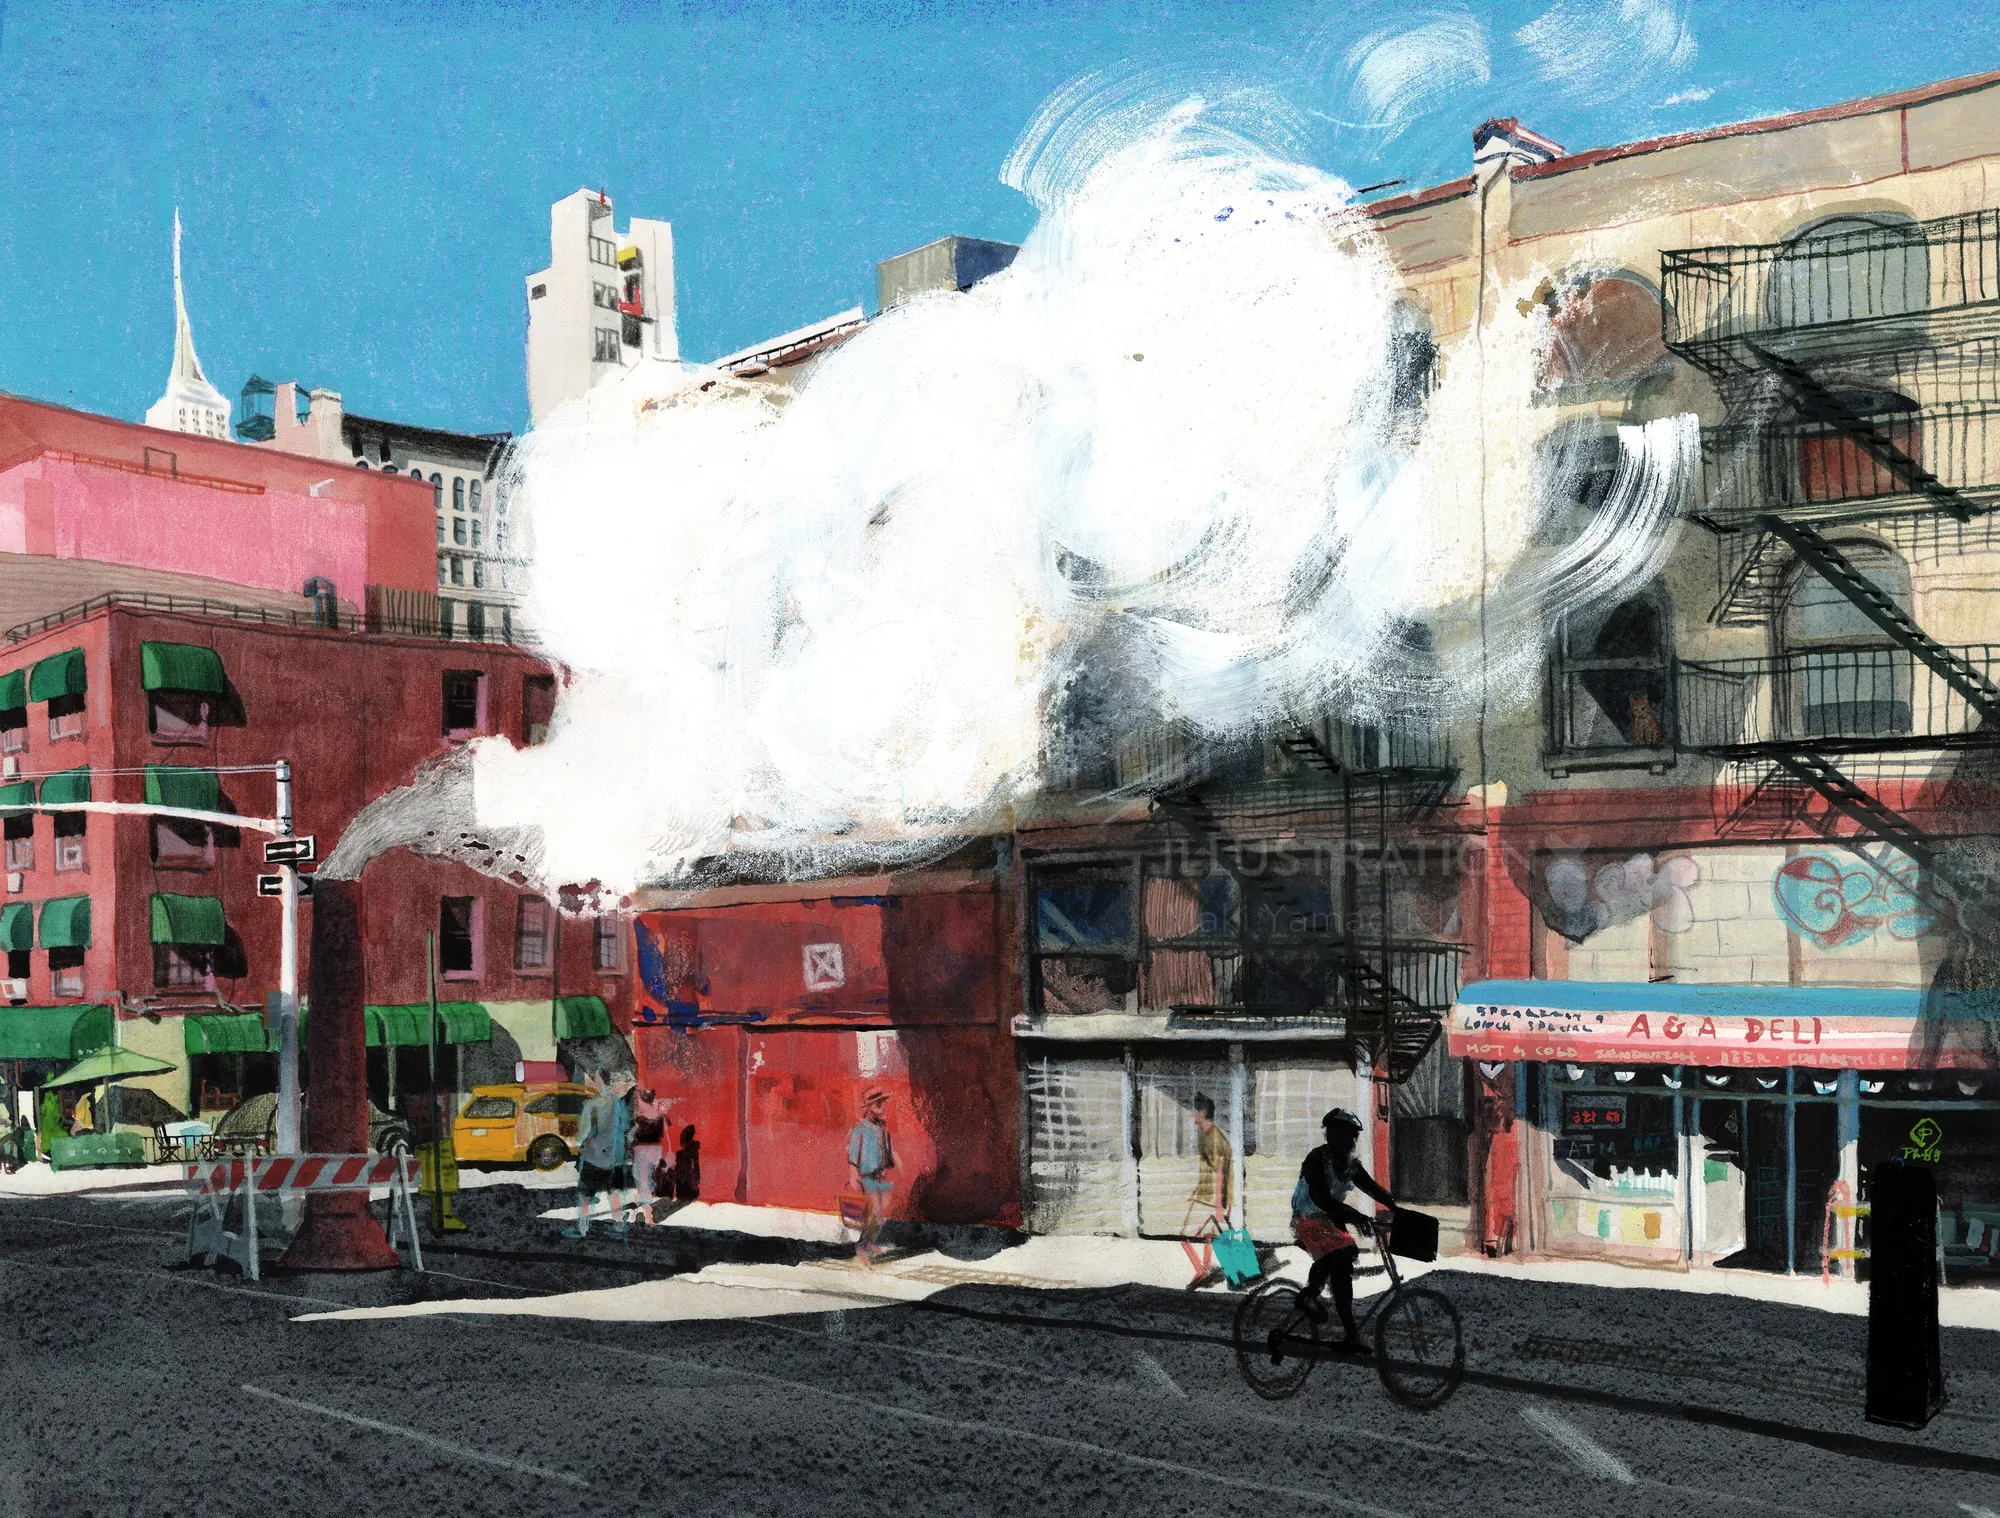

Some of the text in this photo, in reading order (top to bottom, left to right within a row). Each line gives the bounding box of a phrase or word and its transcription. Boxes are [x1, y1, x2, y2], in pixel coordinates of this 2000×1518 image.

[1744, 1017, 1822, 1045] DELI
[1466, 1043, 1505, 1057] HOT
[1535, 1046, 1583, 1058] COLD
[1568, 1140, 1618, 1158] ATM
